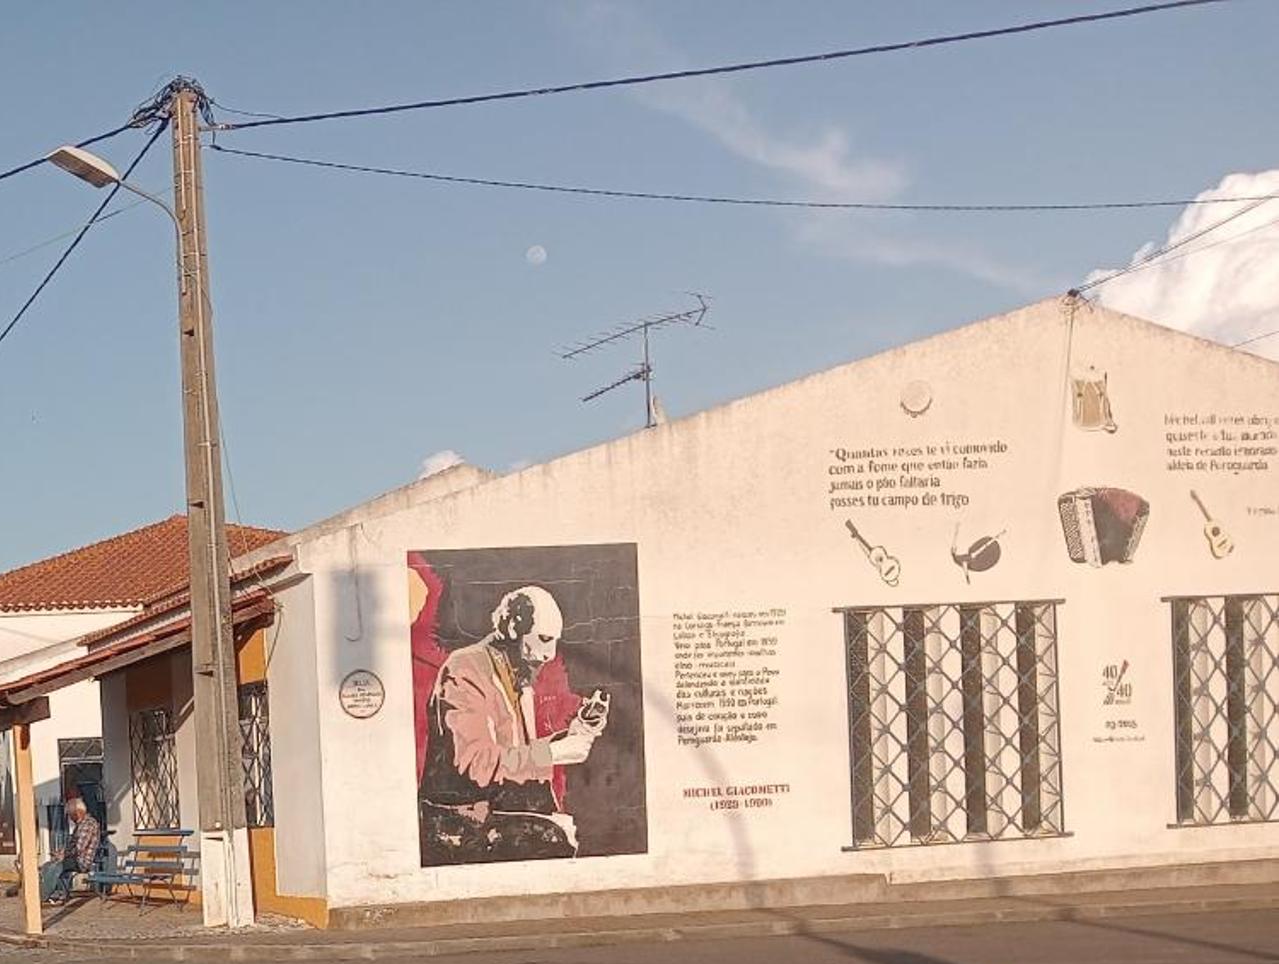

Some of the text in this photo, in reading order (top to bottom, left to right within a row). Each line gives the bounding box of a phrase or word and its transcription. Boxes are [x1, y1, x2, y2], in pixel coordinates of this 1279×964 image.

[866, 479, 874, 489] o
[867, 495, 879, 506] tu
[881, 495, 918, 510] campo
[921, 491, 937, 506] de
[940, 492, 969, 510] trigo
[683, 784, 790, 798] MICHEL GIACOMETTI
